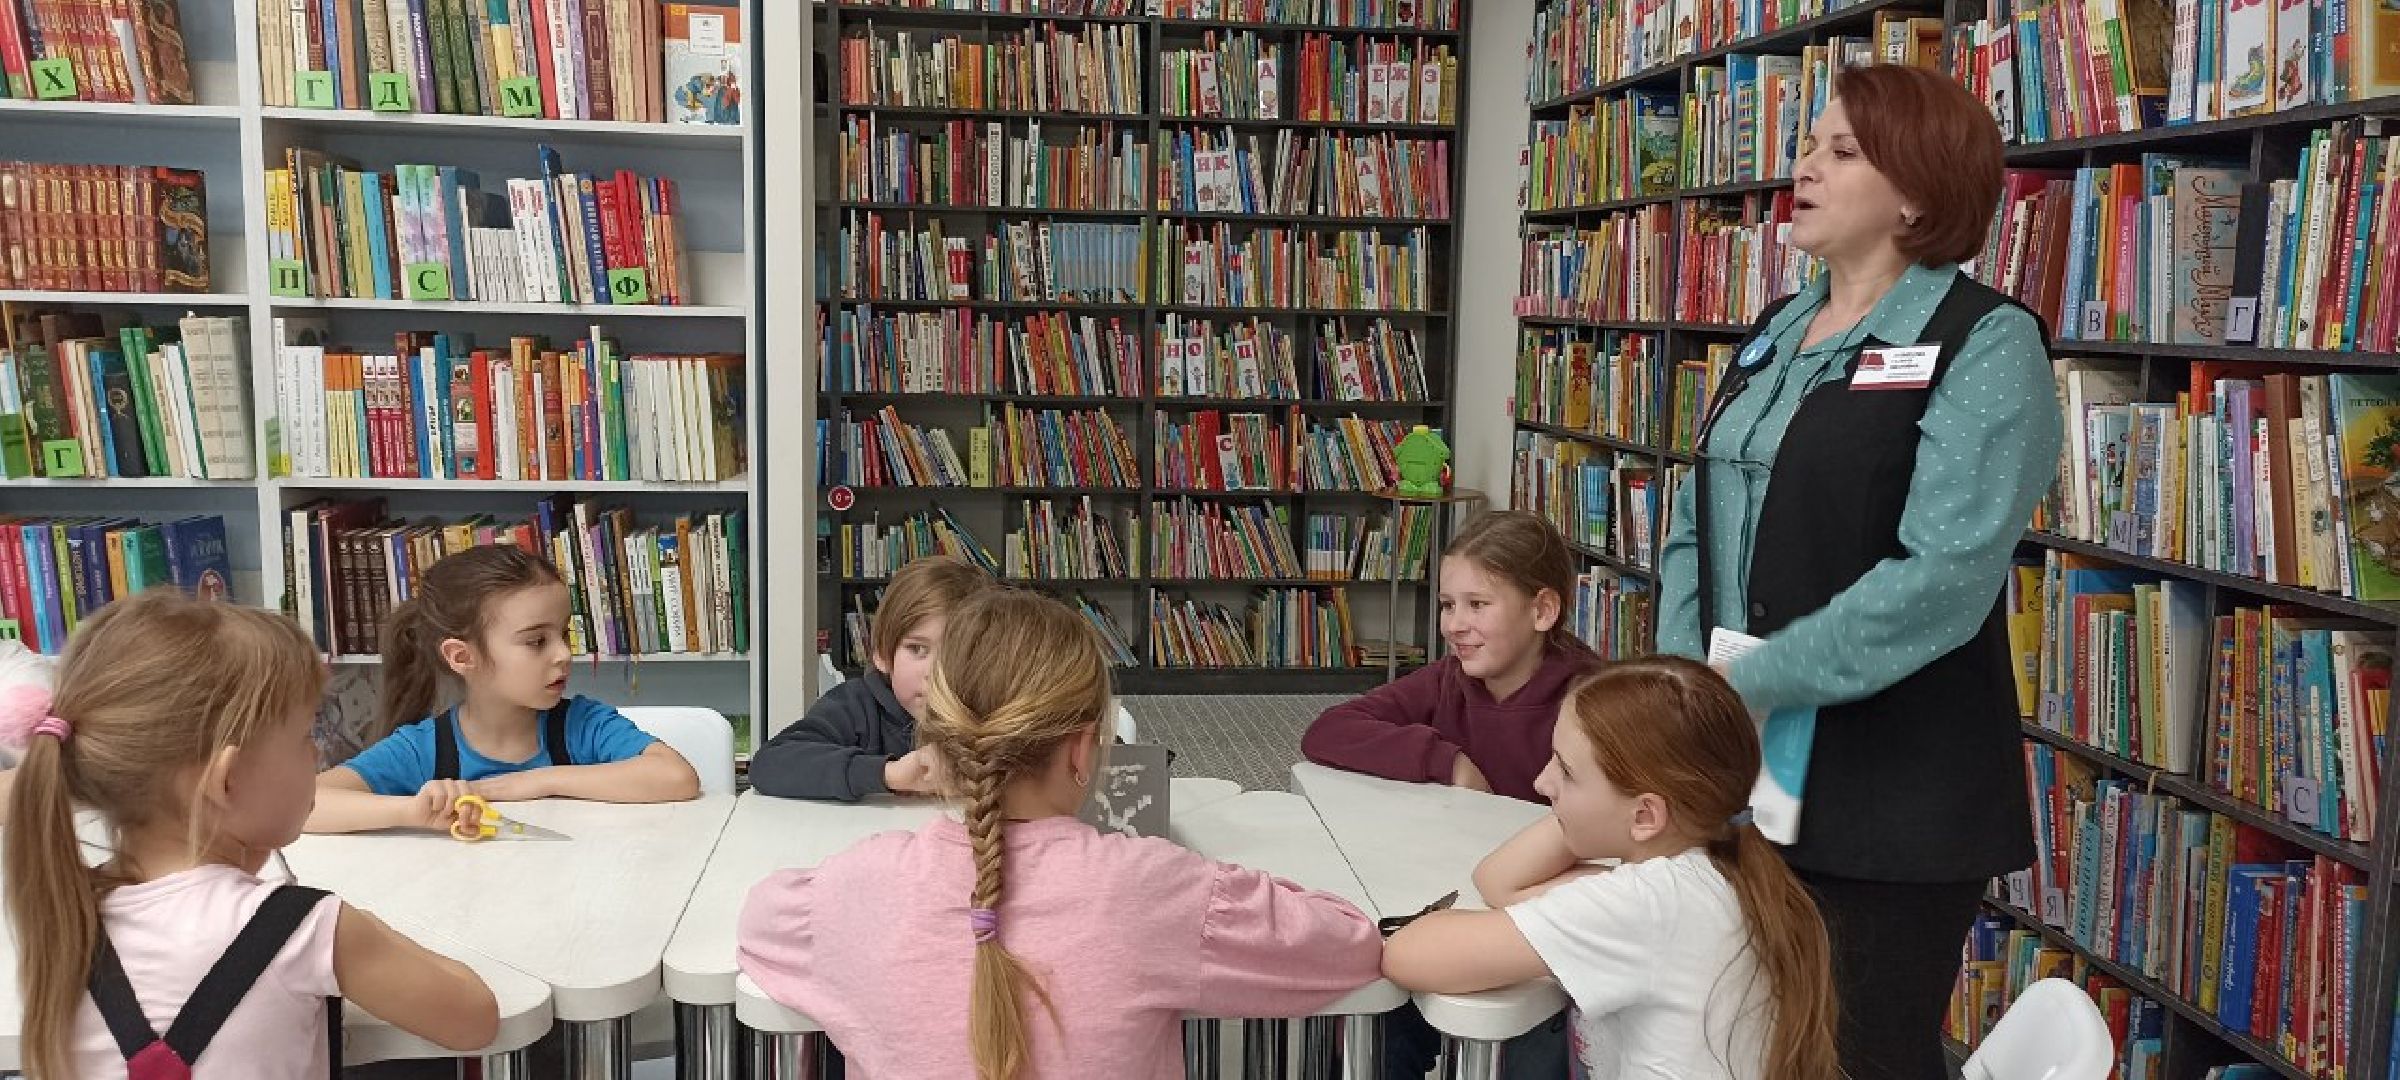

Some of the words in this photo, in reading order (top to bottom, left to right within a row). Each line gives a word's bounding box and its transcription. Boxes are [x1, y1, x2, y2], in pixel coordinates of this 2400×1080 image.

[1200, 57, 1212, 72] Г
[1372, 69, 1384, 82] Е
[41, 67, 65, 91] Х
[306, 79, 324, 101] Г
[379, 82, 402, 107] Д
[506, 87, 534, 108] М
[279, 267, 299, 288] П
[417, 270, 437, 293] С
[615, 276, 640, 297] Ф
[2088, 310, 2101, 332] В
[2233, 307, 2249, 331] Г
[1188, 343, 1202, 356] О
[1219, 437, 1231, 451] С
[53, 448, 72, 469] Г
[2047, 700, 2057, 722] Р
[2294, 786, 2311, 814] С
[2047, 895, 2057, 918] Я
